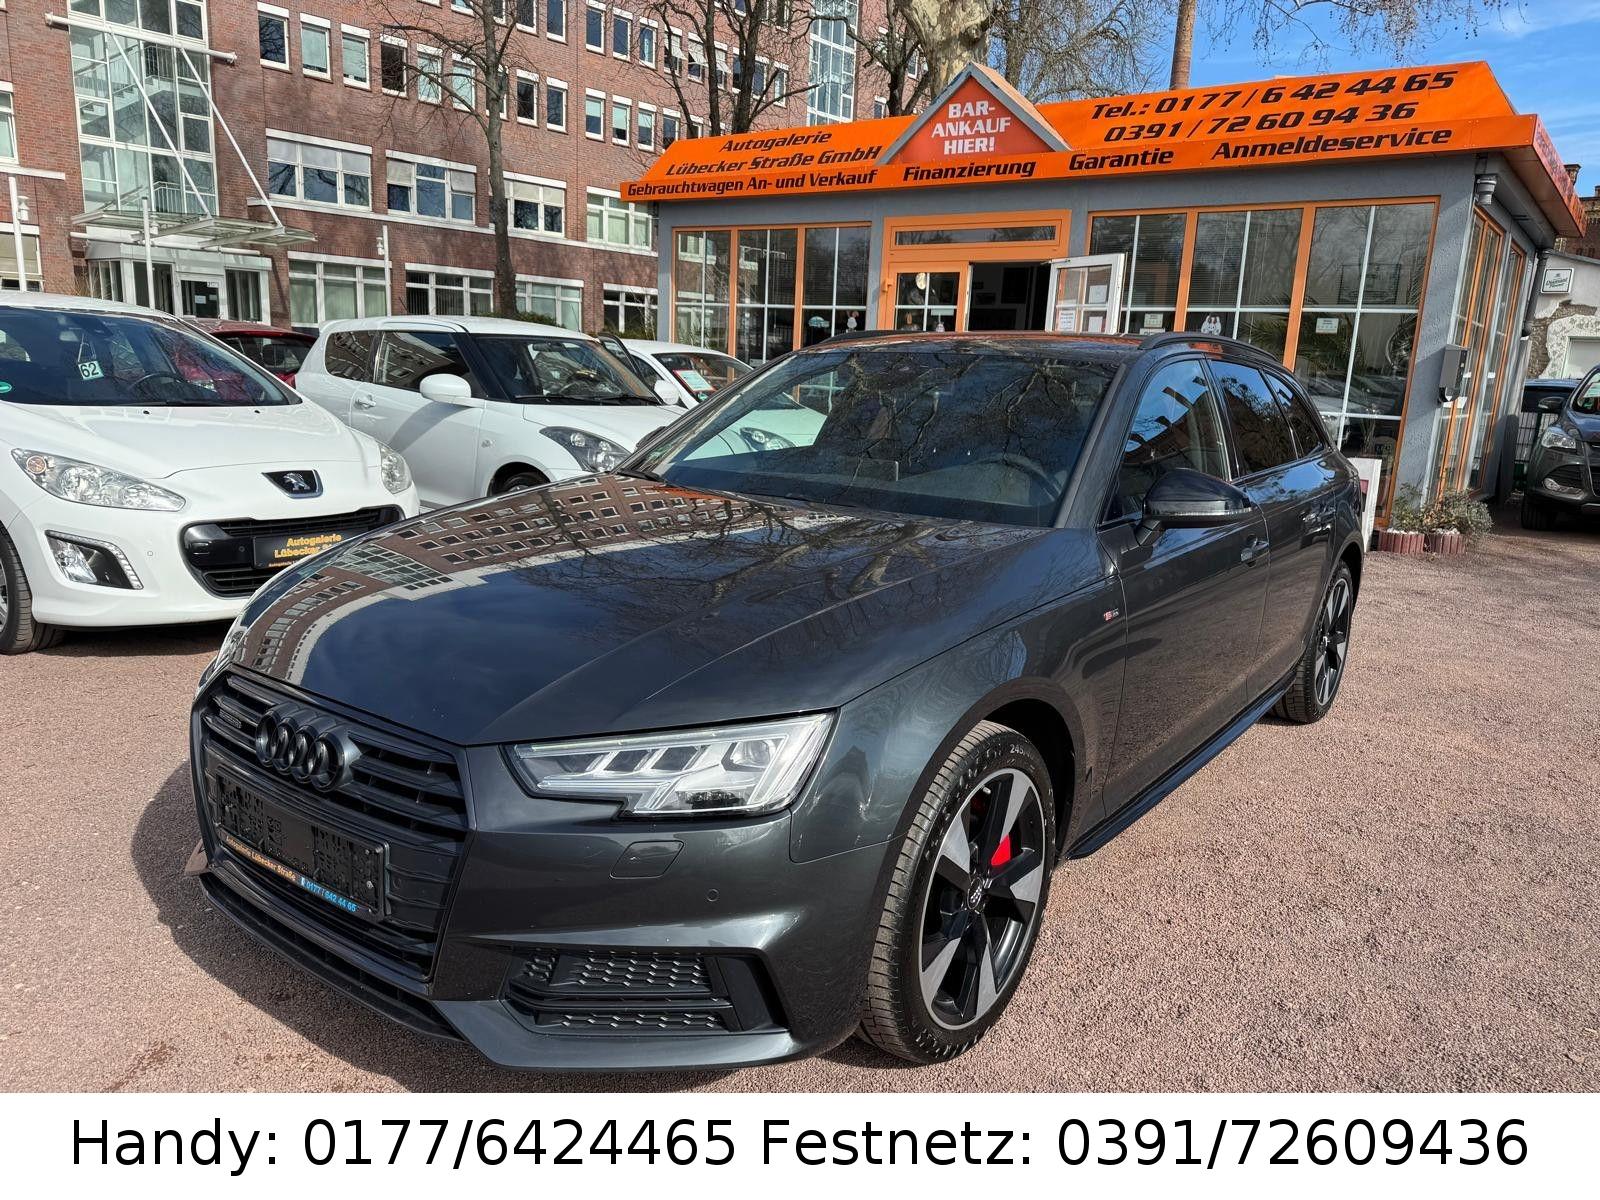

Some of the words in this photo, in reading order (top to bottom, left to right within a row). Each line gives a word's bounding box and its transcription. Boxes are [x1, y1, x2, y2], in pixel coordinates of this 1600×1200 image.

[1091, 101, 1150, 120] Tel.:
[1154, 91, 1242, 114] 0177
[1290, 82, 1341, 101] 42
[1344, 76, 1397, 96] 44
[1402, 71, 1458, 92] 65
[948, 100, 996, 119] BAR-
[931, 117, 1012, 139] ANKAUF
[1103, 121, 1184, 142] 0391
[1206, 115, 1251, 135] 72
[1255, 111, 1305, 131] 60
[1308, 106, 1360, 126] 94
[1364, 101, 1419, 122] 36
[719, 131, 833, 153] Autogalerie
[943, 136, 996, 155] HIER!
[1210, 127, 1453, 161] Anmeldeservice
[665, 160, 748, 176] Lübecker
[748, 152, 815, 170] Straße
[817, 145, 883, 165] GmbH
[1068, 147, 1175, 171] Garantie
[627, 180, 744, 196] Gebrauchtwagen
[746, 176, 773, 191] An-
[775, 173, 806, 189] und
[808, 169, 879, 187] Verkauf
[902, 161, 1037, 182] Finanzierung
[80, 362, 100, 378] 62
[286, 533, 342, 546] Autogalerie
[274, 546, 320, 558] Lübecker
